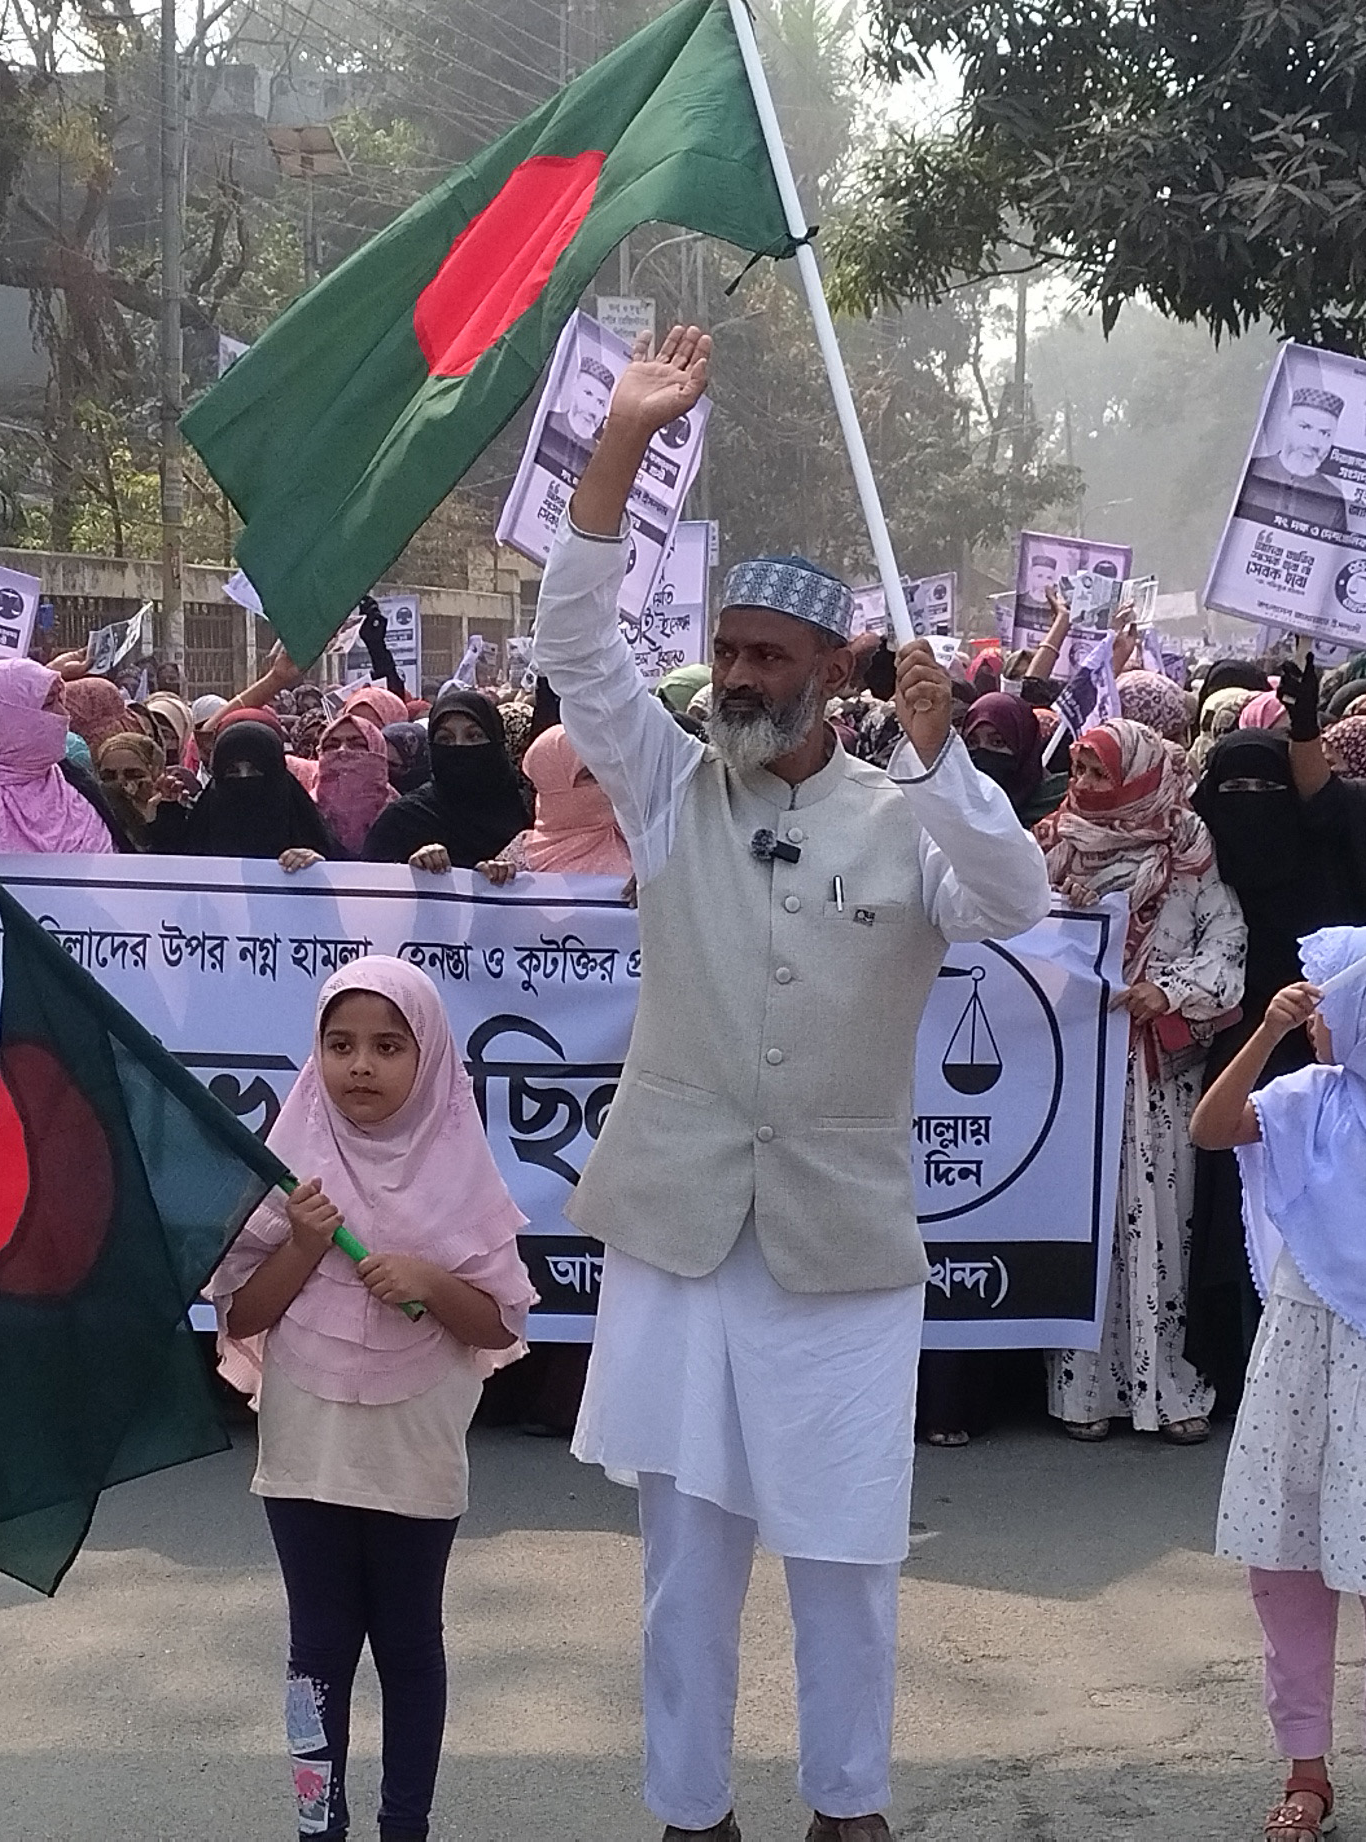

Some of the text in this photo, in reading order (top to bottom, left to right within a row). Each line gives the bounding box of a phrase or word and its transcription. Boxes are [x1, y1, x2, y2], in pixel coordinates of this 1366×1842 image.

[157, 919, 228, 974] উপর
[236, 935, 283, 982] নগ্ন
[482, 946, 506, 980] ও
[923, 1149, 984, 1189] দিন
